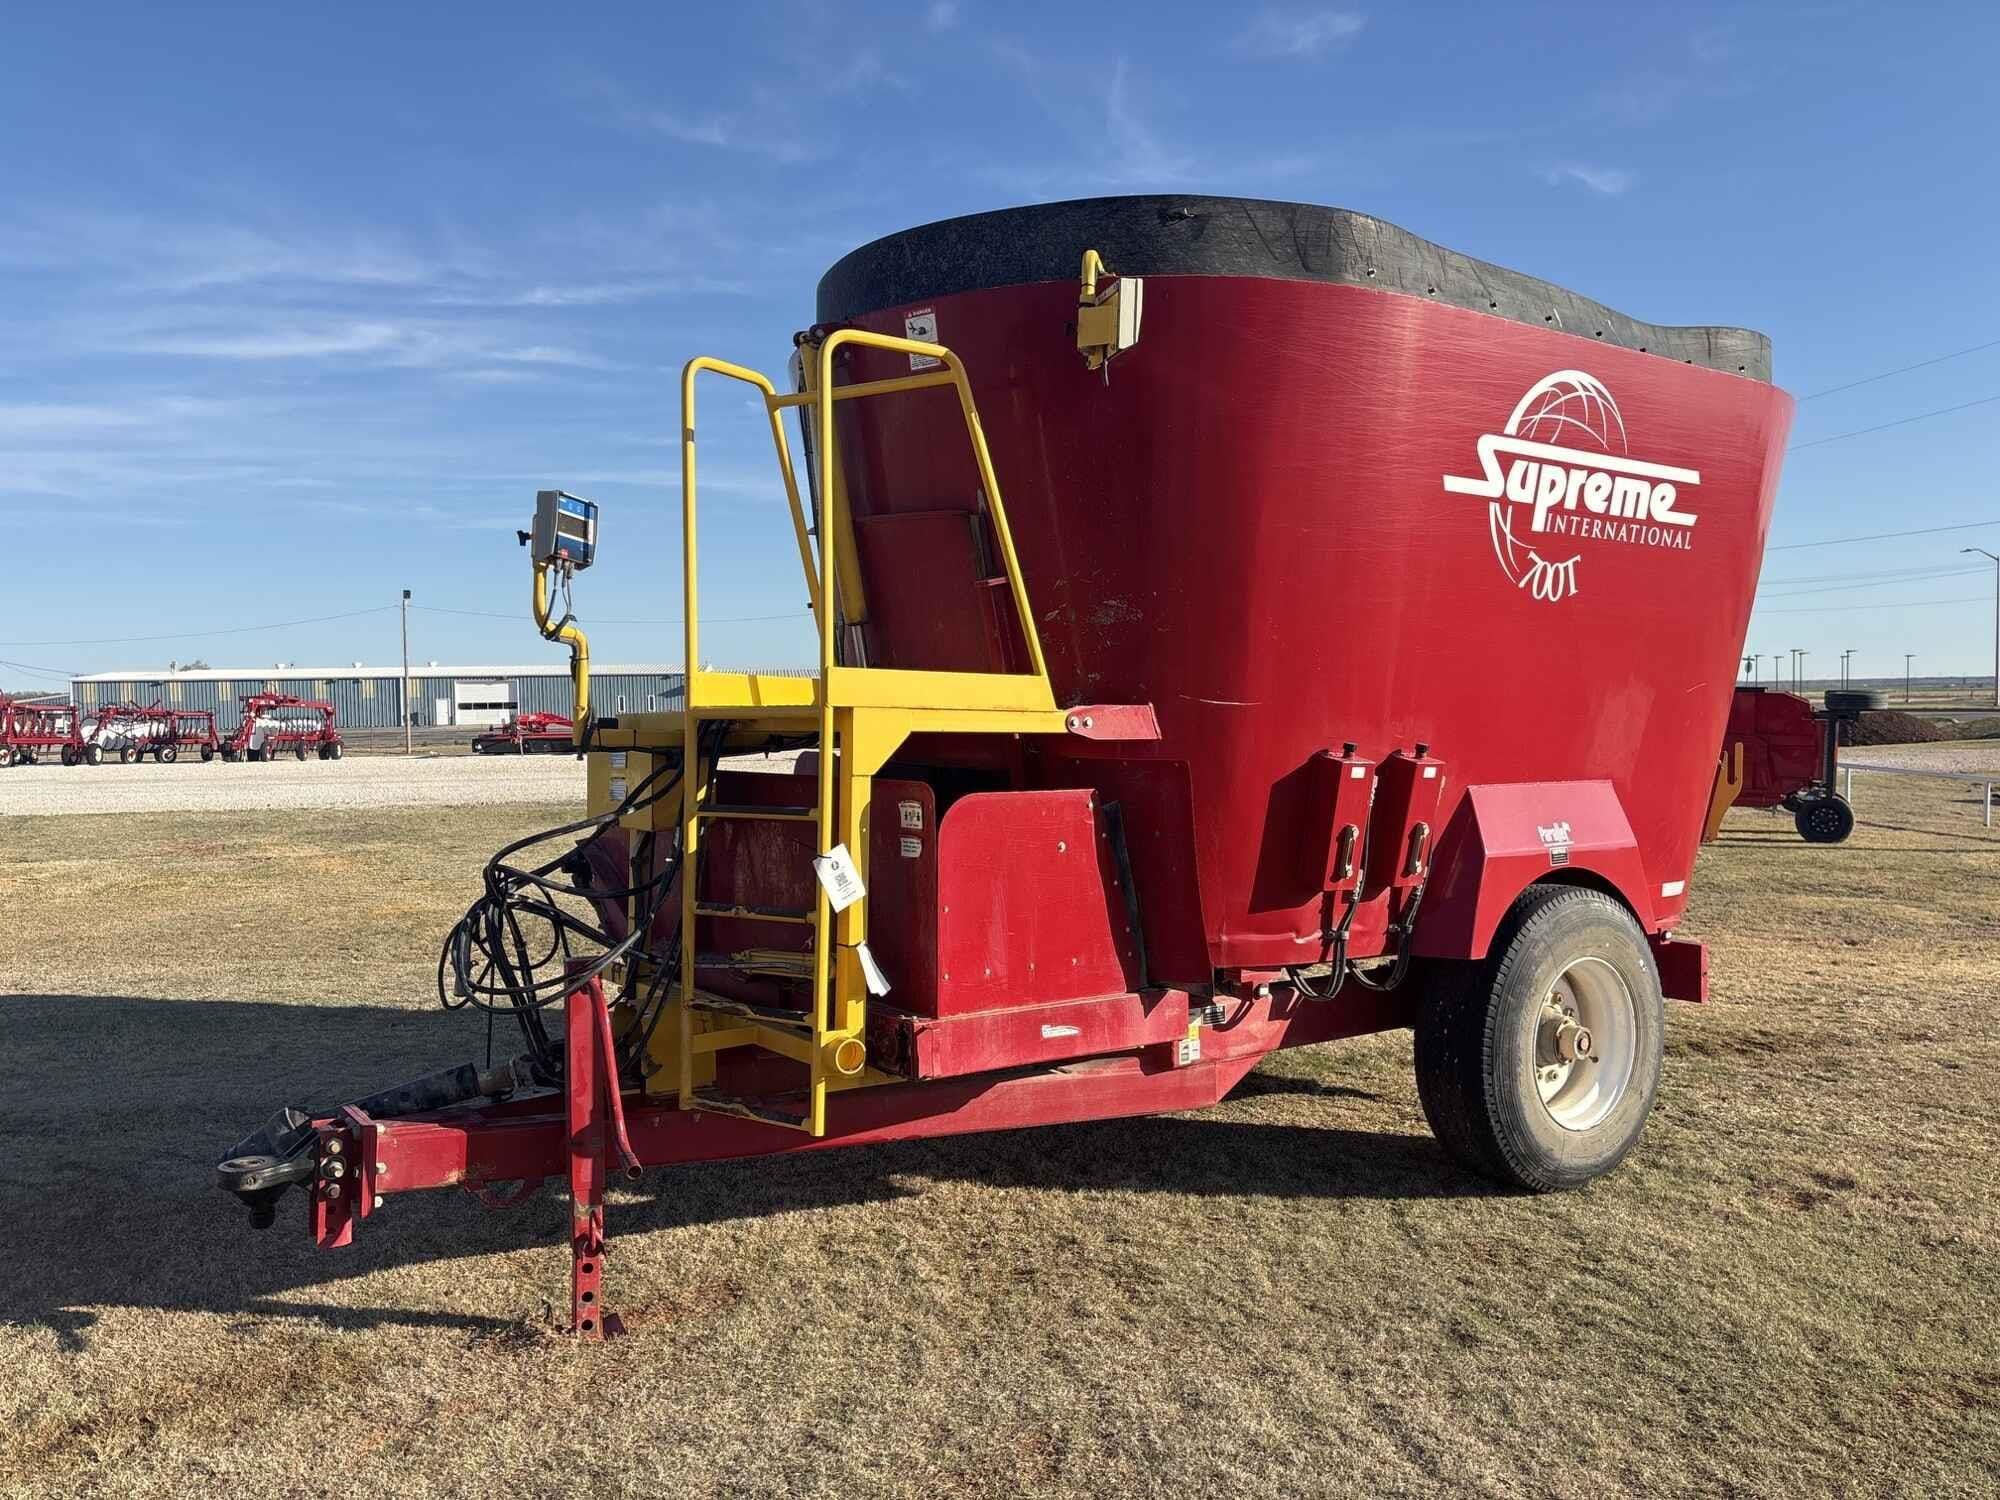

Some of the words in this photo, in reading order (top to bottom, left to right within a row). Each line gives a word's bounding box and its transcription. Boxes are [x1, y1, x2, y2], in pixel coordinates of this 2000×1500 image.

[1443, 435, 1700, 532] Supreme
[1547, 514, 1692, 550] INTERNATIONAL
[1518, 551, 1581, 601] 700T
